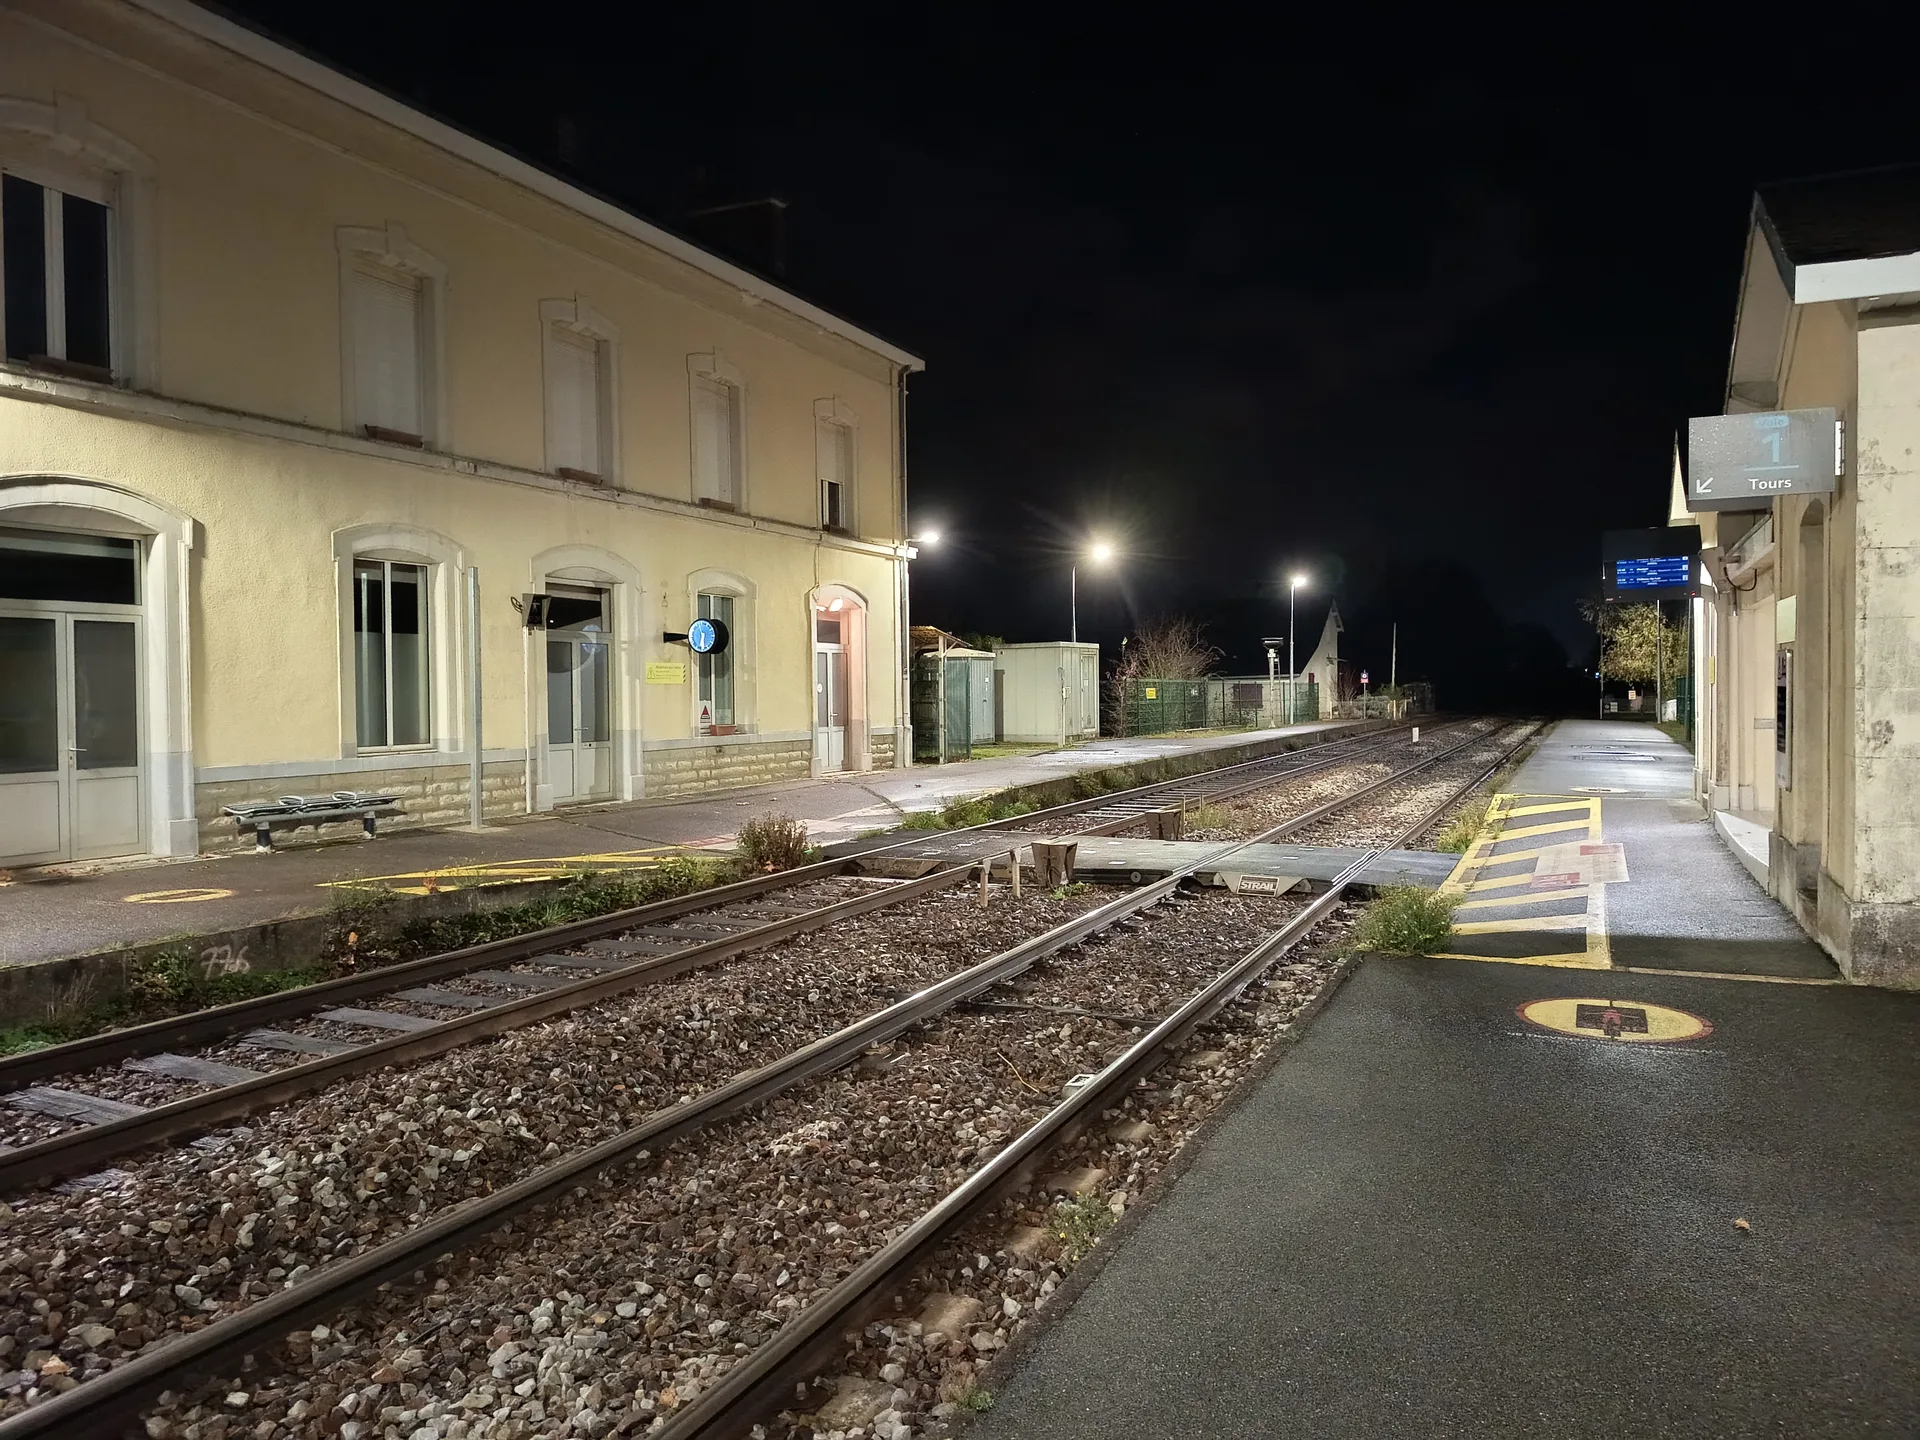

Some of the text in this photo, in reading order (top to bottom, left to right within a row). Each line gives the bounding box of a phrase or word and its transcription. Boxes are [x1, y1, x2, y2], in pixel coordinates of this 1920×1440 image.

[1761, 431, 1780, 463] 1
[1748, 477, 1792, 490] Tours
[1240, 881, 1277, 891] STRAIL
